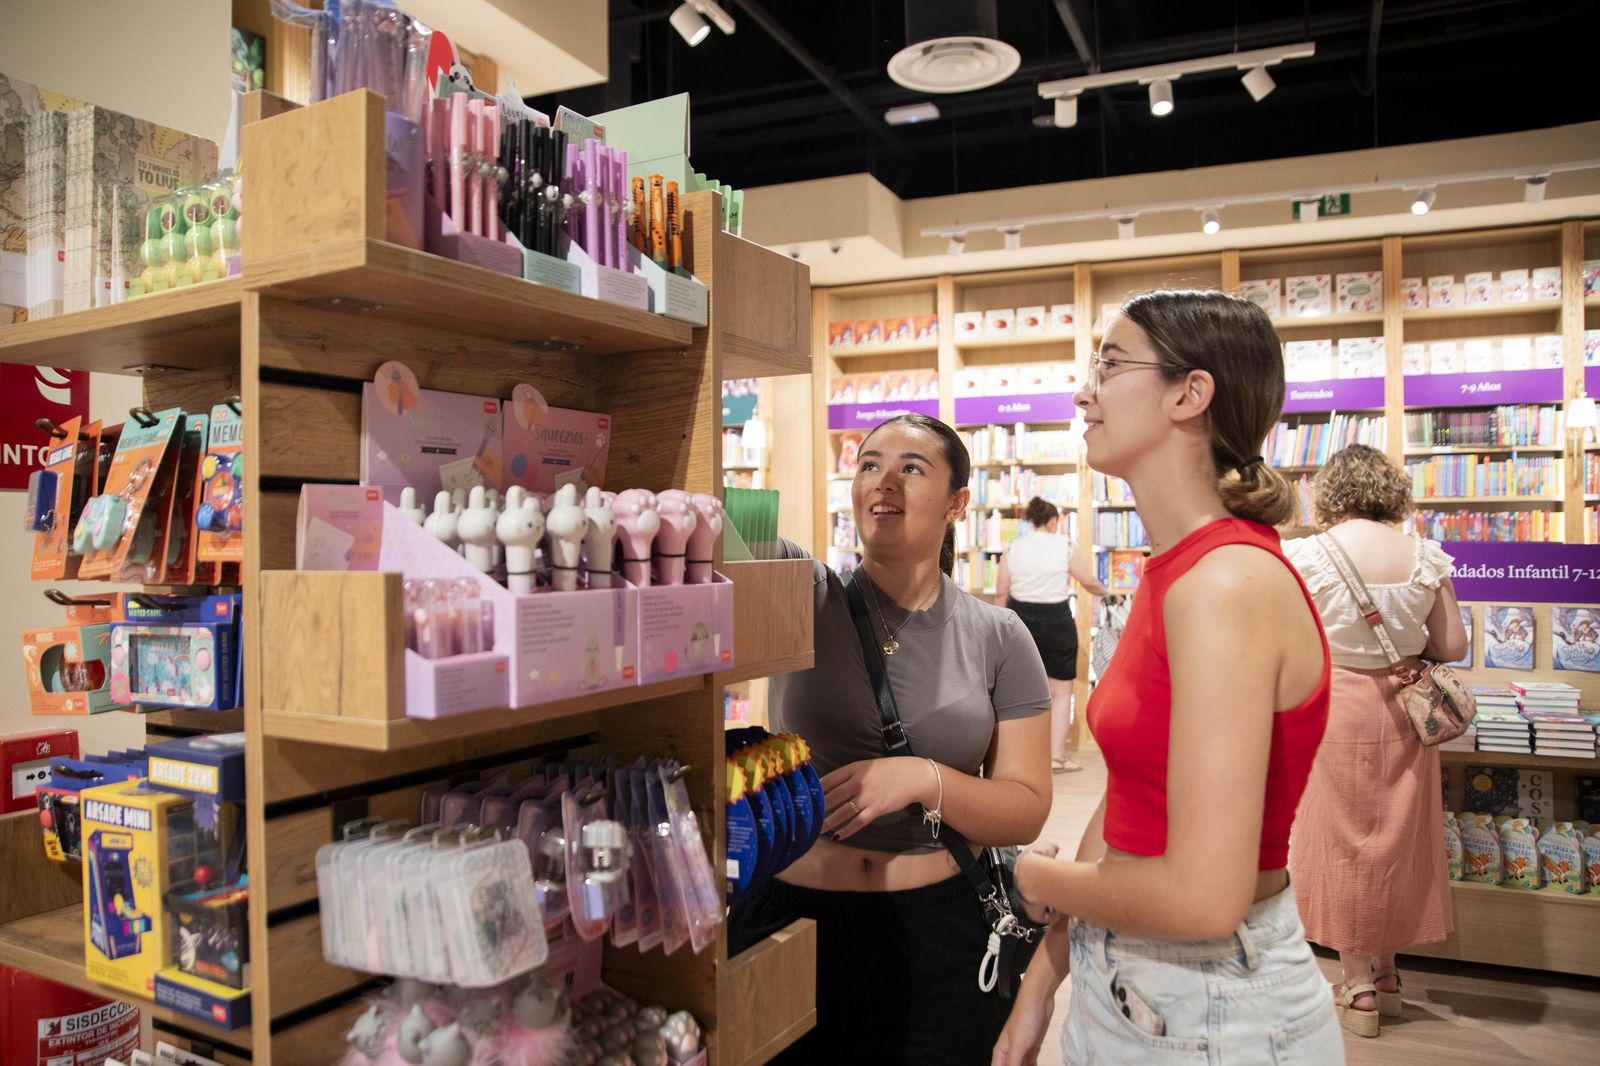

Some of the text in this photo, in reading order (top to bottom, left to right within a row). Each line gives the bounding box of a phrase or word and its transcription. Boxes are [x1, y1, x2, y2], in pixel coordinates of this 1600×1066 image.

[138, 160, 147, 169] TO
[148, 163, 172, 176] TRAVEL
[138, 168, 180, 190] TO LIVE
[1508, 564, 1569, 579] Infantil
[86, 800, 151, 832] ARCADE MINI
[48, 1030, 95, 1048] EXTINTOR
[96, 1025, 109, 1038] DE
